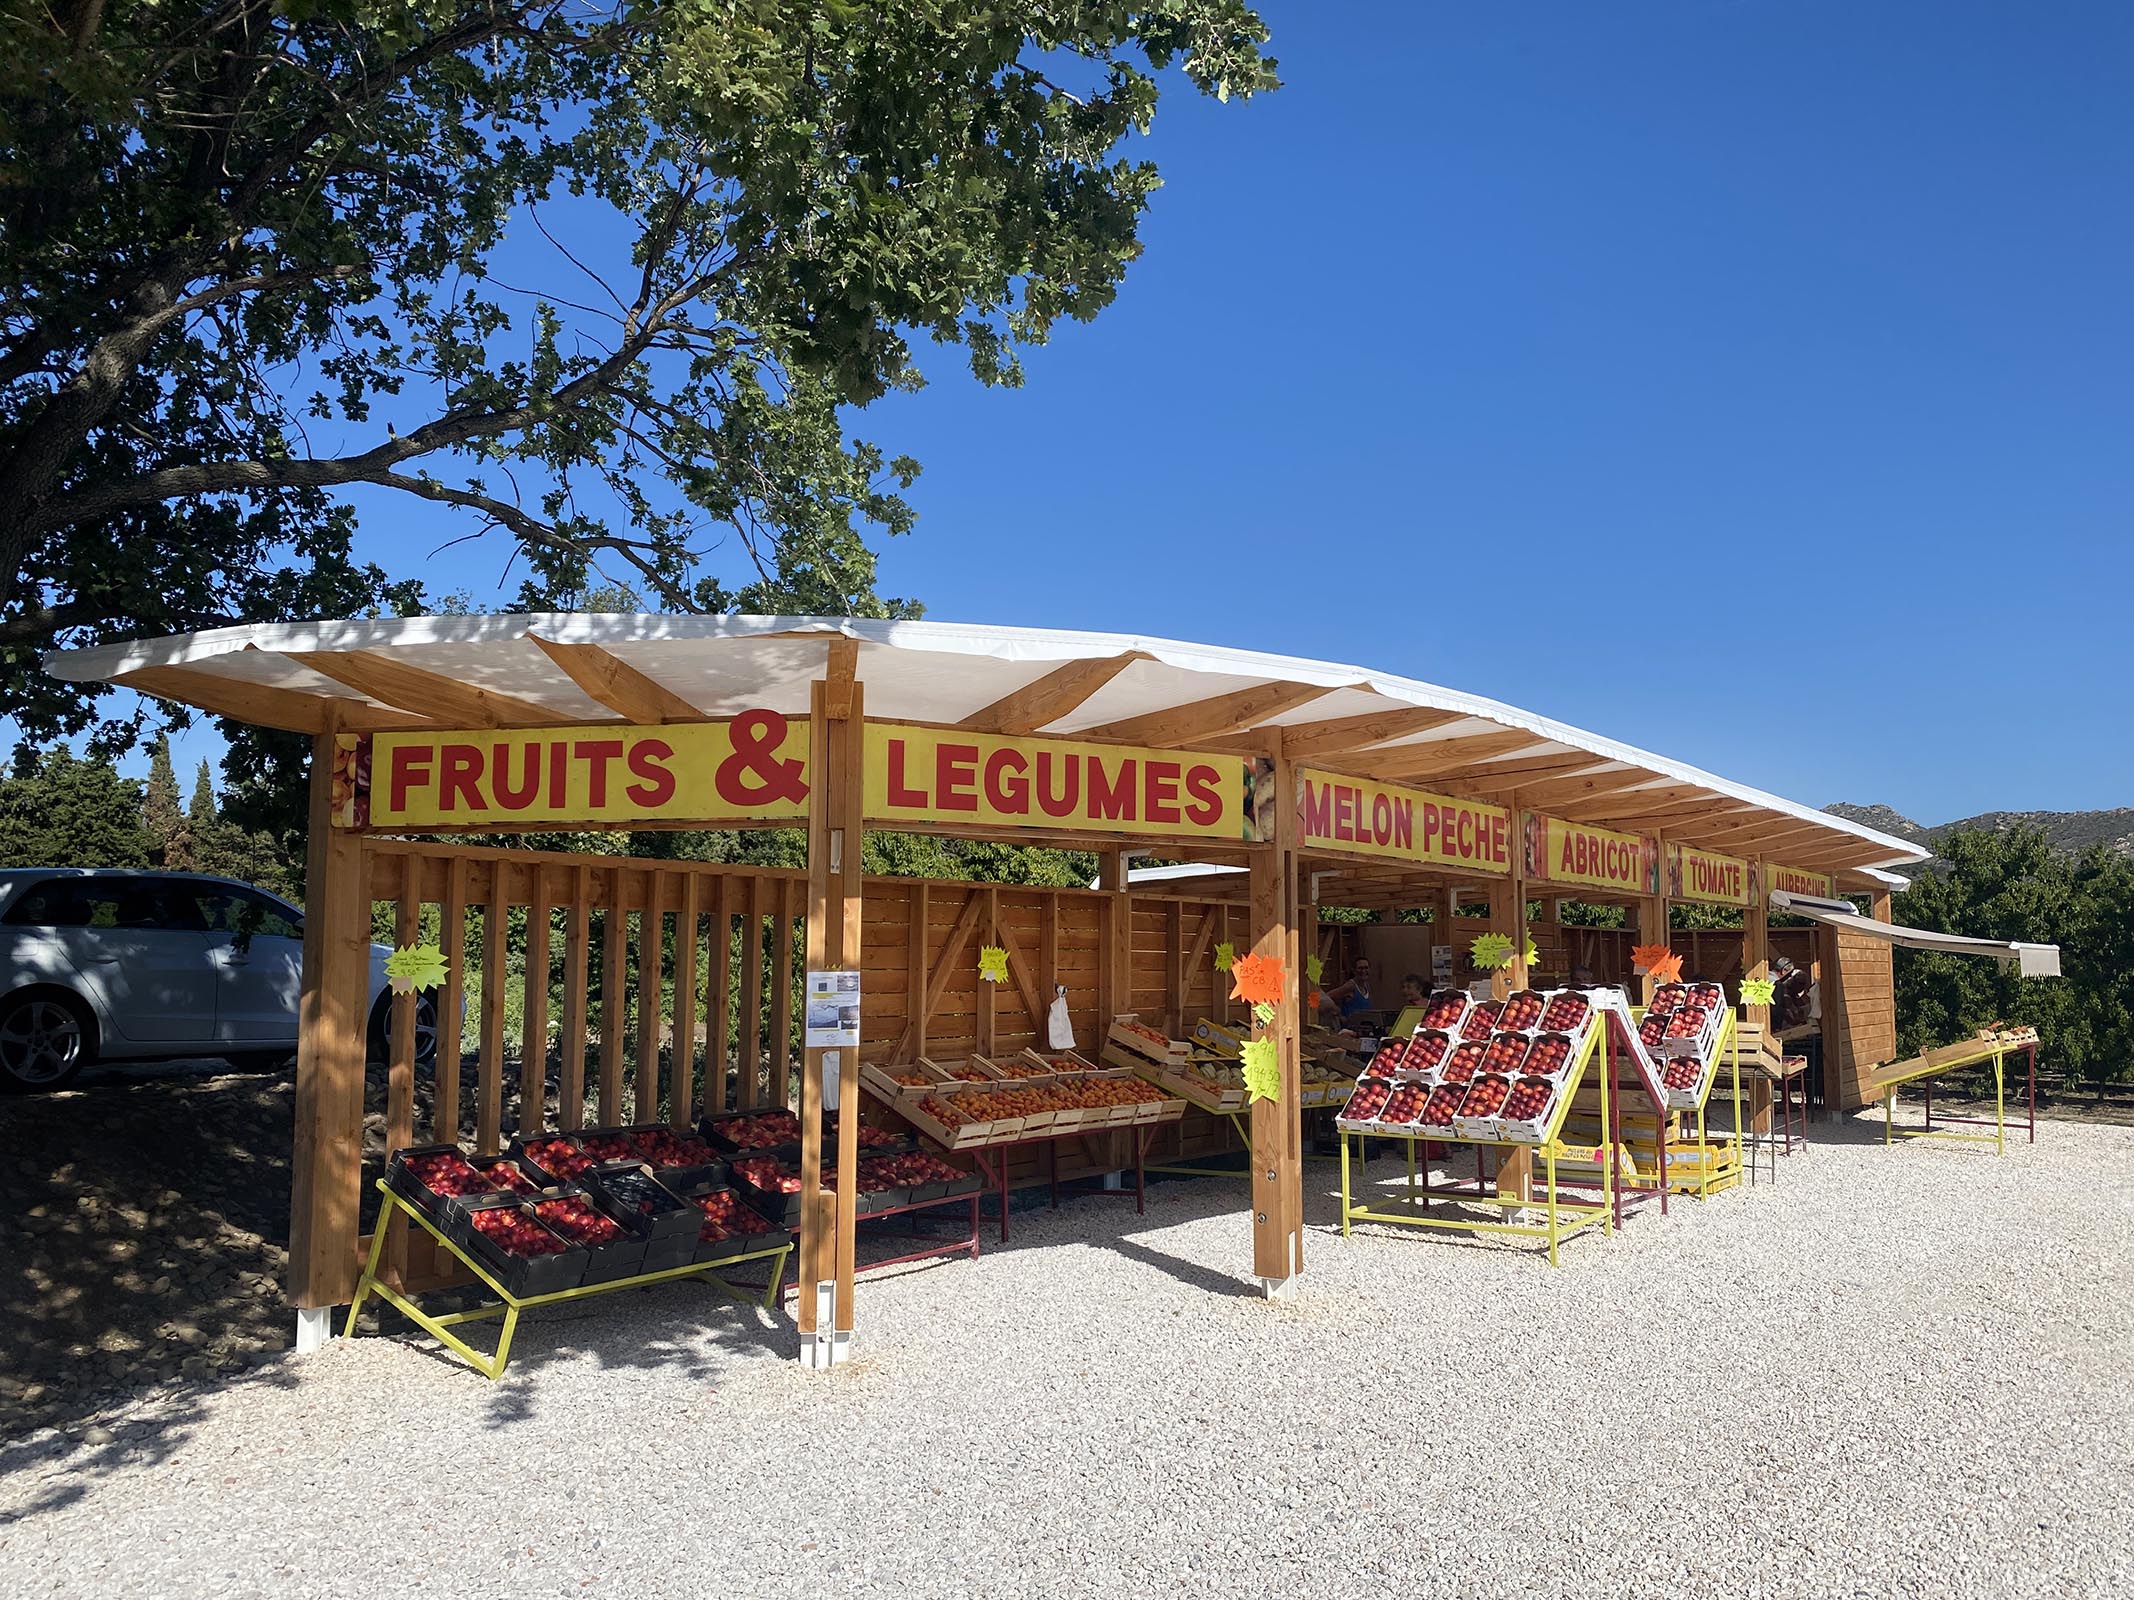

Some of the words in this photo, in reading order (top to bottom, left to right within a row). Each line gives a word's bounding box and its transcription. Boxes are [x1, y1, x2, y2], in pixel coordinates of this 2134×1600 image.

[389, 738, 677, 812] FRUITS
[714, 708, 810, 807] &
[887, 739, 1223, 827] LEGUMES
[1305, 779, 1413, 850] MELON
[1423, 802, 1506, 864] PECHE
[1560, 830, 1640, 883] ABRICOT
[1689, 855, 1741, 897] TOMATE
